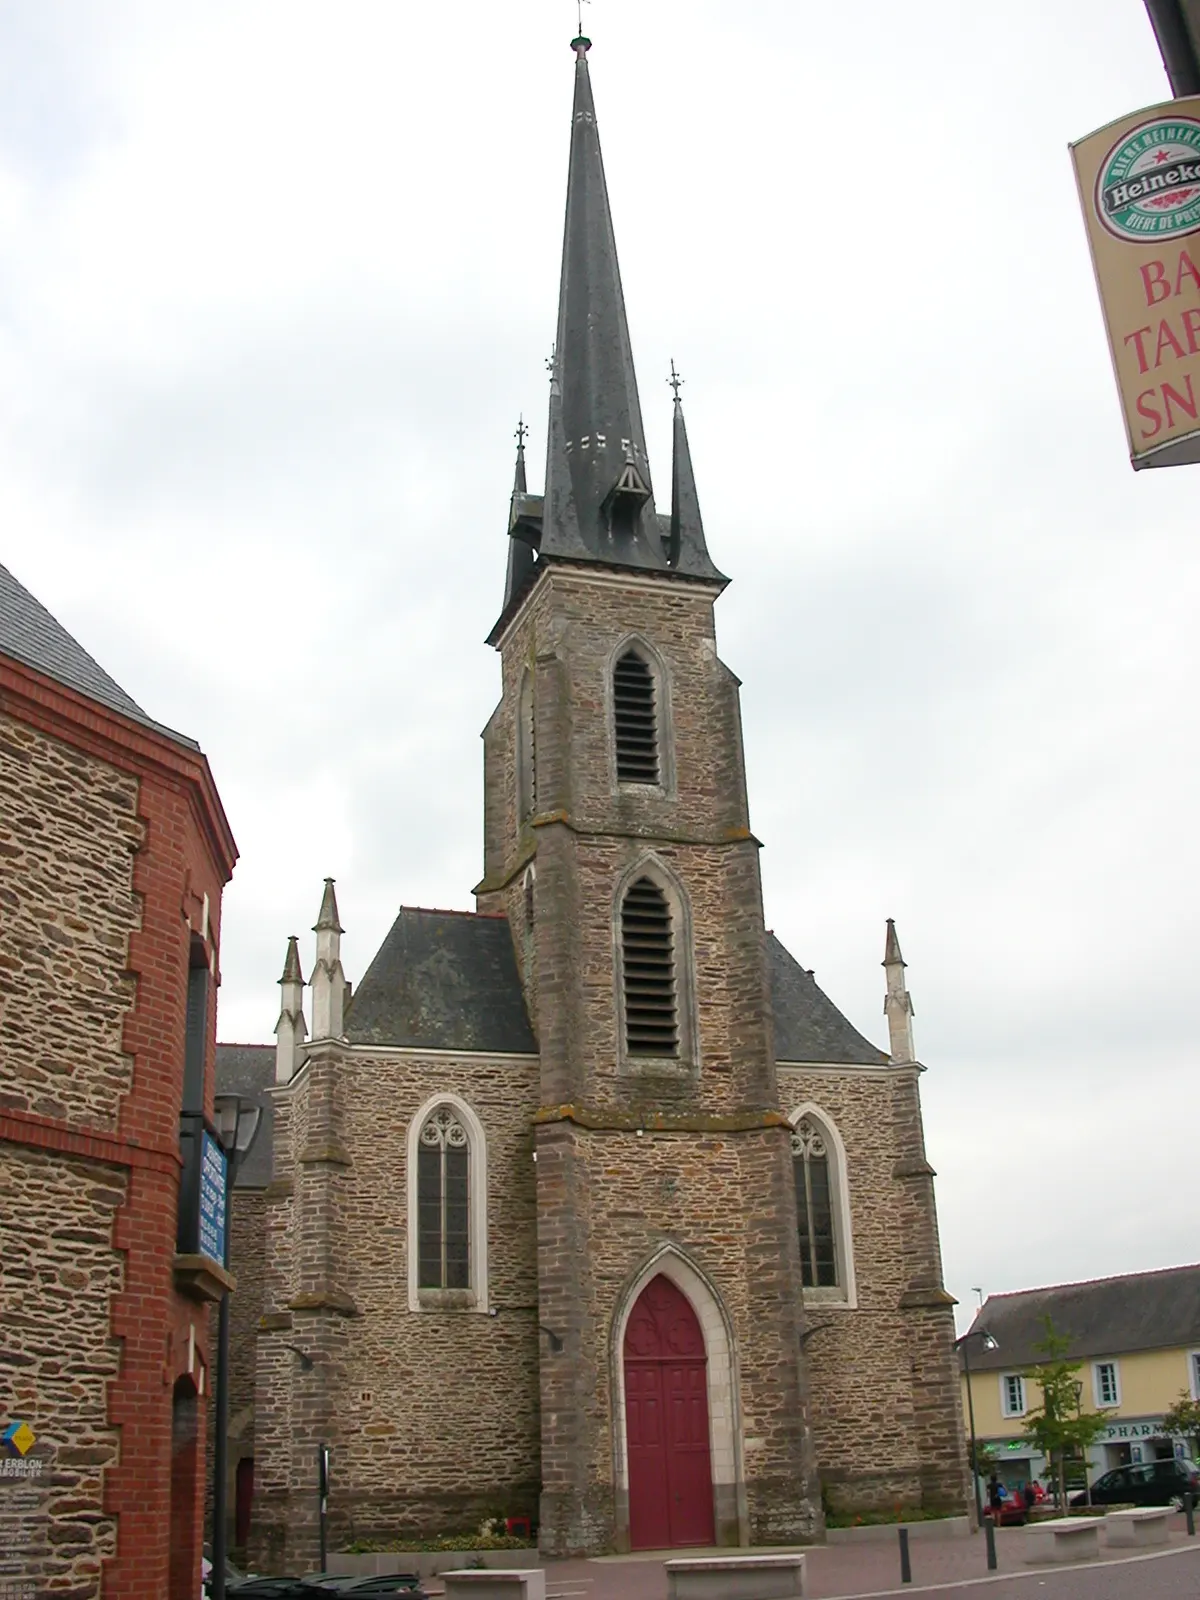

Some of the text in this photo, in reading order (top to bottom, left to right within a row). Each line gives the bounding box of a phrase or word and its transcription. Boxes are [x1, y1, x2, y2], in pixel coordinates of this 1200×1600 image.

[1159, 215, 1173, 230] DE
[1175, 203, 1200, 226] PRE
[1139, 250, 1200, 307] BA
[1135, 374, 1199, 439] SN
[1107, 1423, 1179, 1438] PHARM
[0, 1468, 42, 1478] MOBILIER
